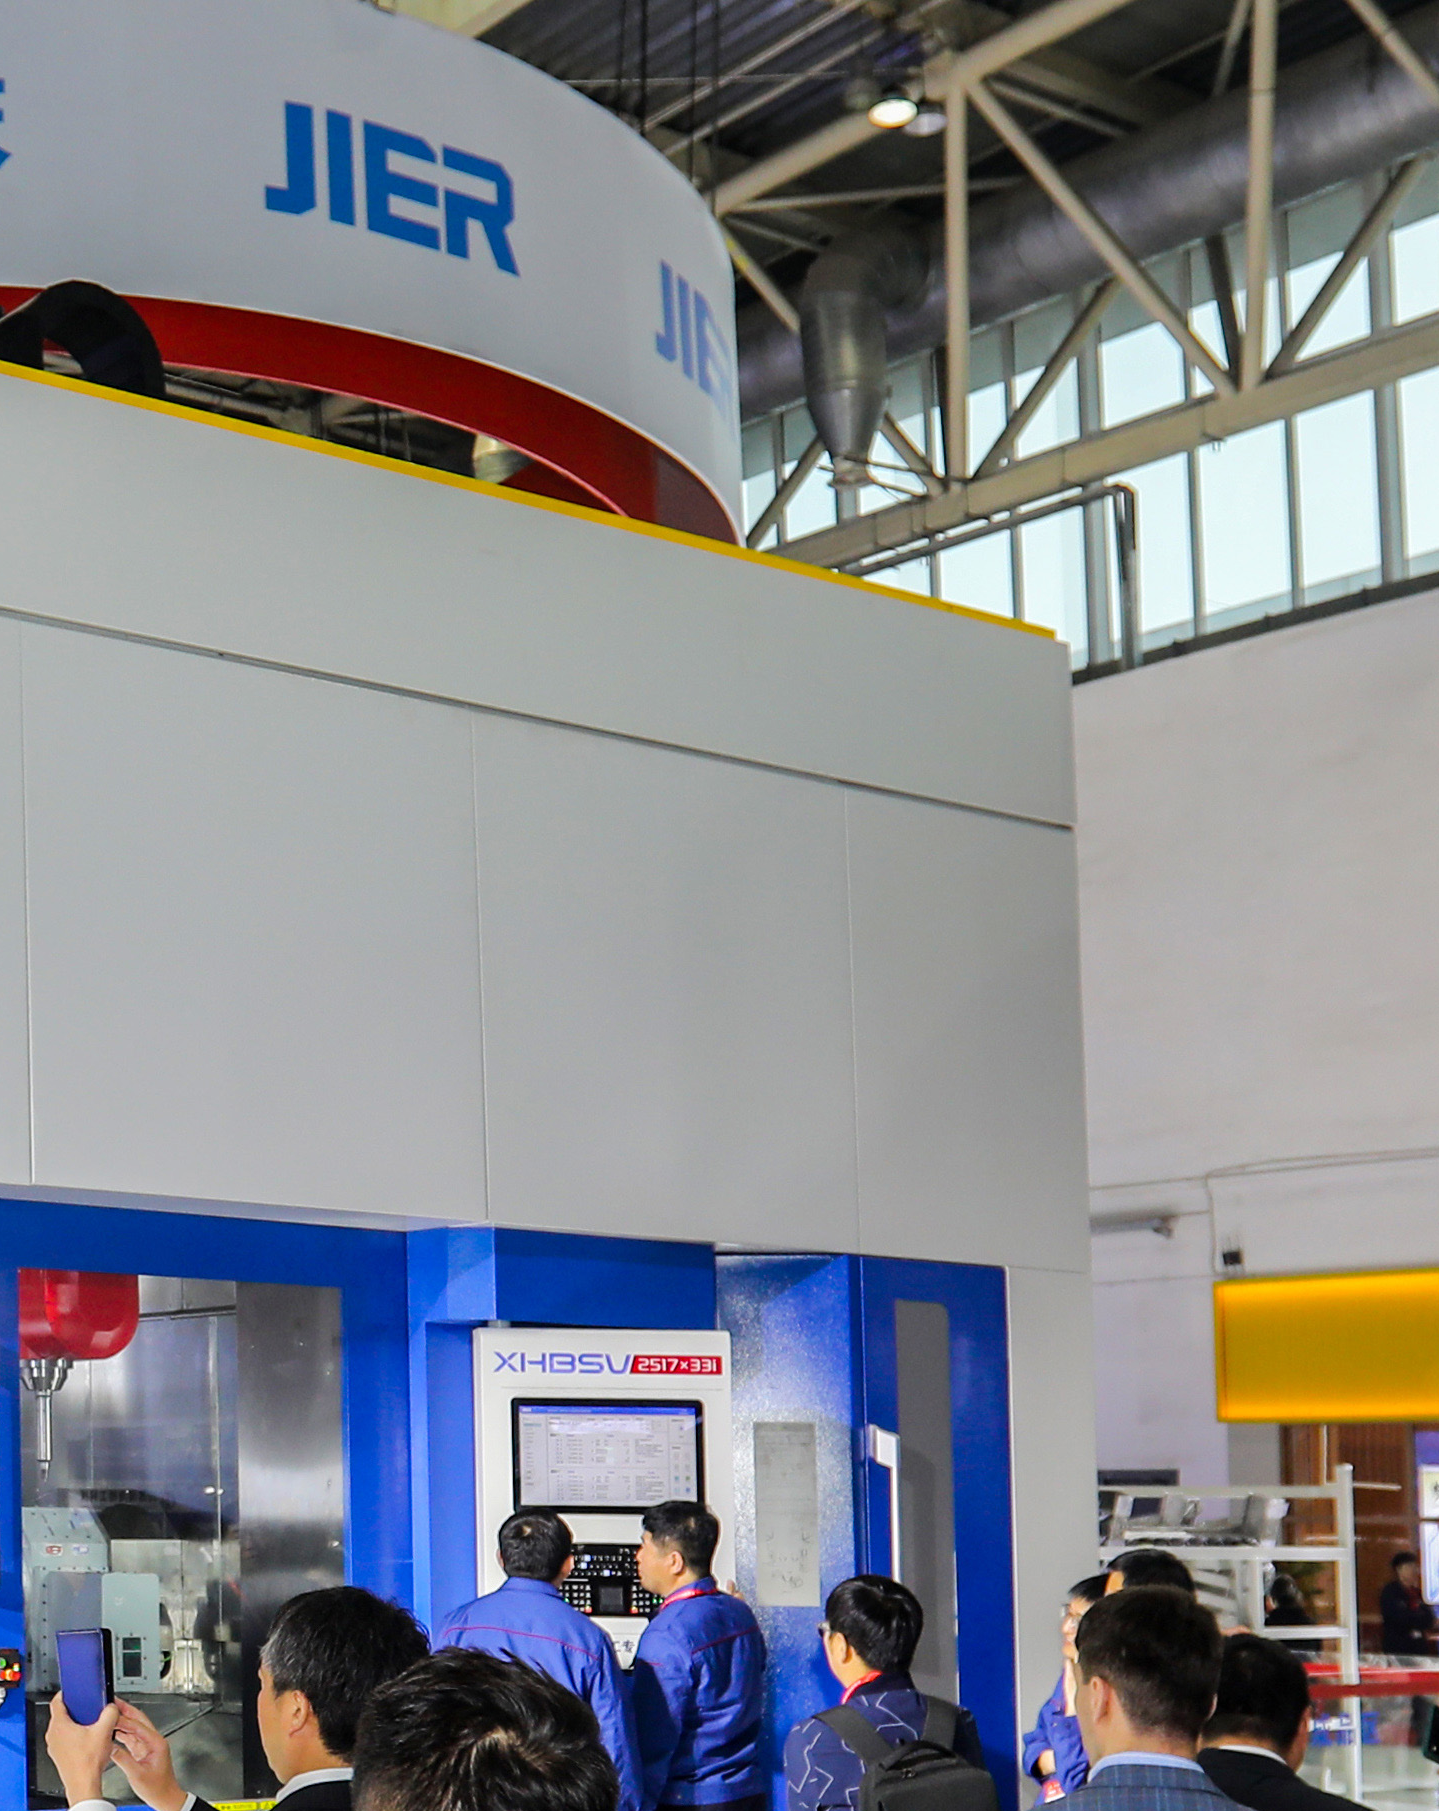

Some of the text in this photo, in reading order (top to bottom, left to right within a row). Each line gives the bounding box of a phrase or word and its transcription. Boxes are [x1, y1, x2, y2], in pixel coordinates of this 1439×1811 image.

[265, 101, 520, 277] JIER
[656, 258, 735, 405] JIE
[493, 1351, 631, 1375] XHBSV
